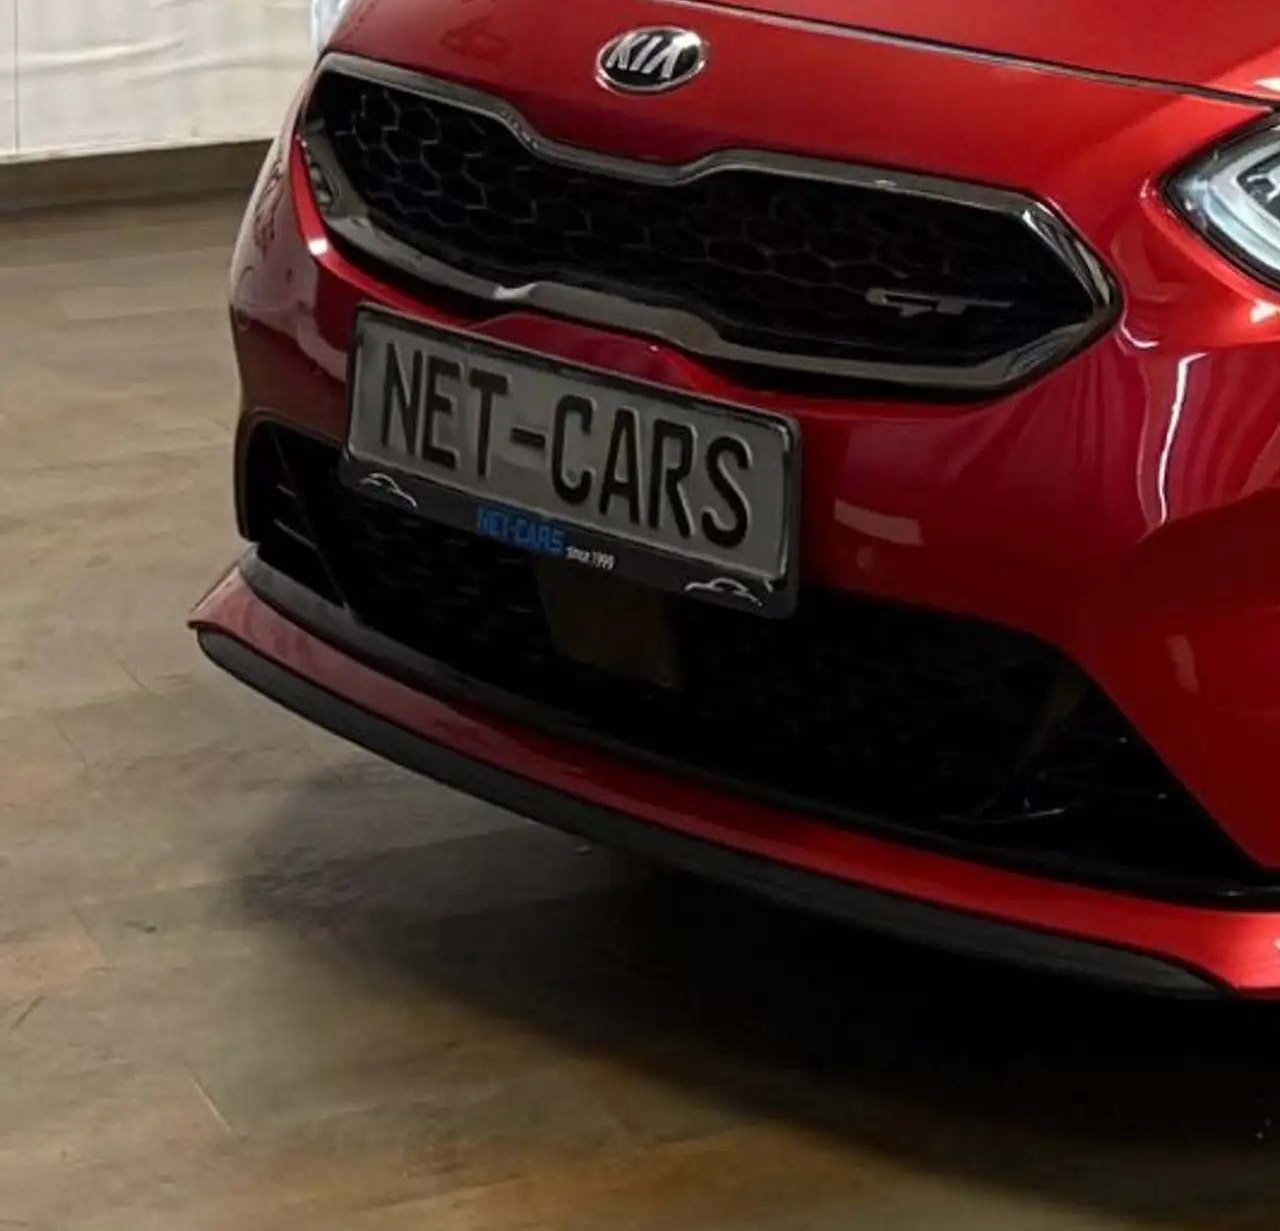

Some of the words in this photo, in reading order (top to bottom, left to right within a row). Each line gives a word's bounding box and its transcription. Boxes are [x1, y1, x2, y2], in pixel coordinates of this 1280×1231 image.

[605, 33, 688, 79] KIA
[381, 342, 752, 548] NET-CARS
[476, 505, 566, 558] NET-CARS
